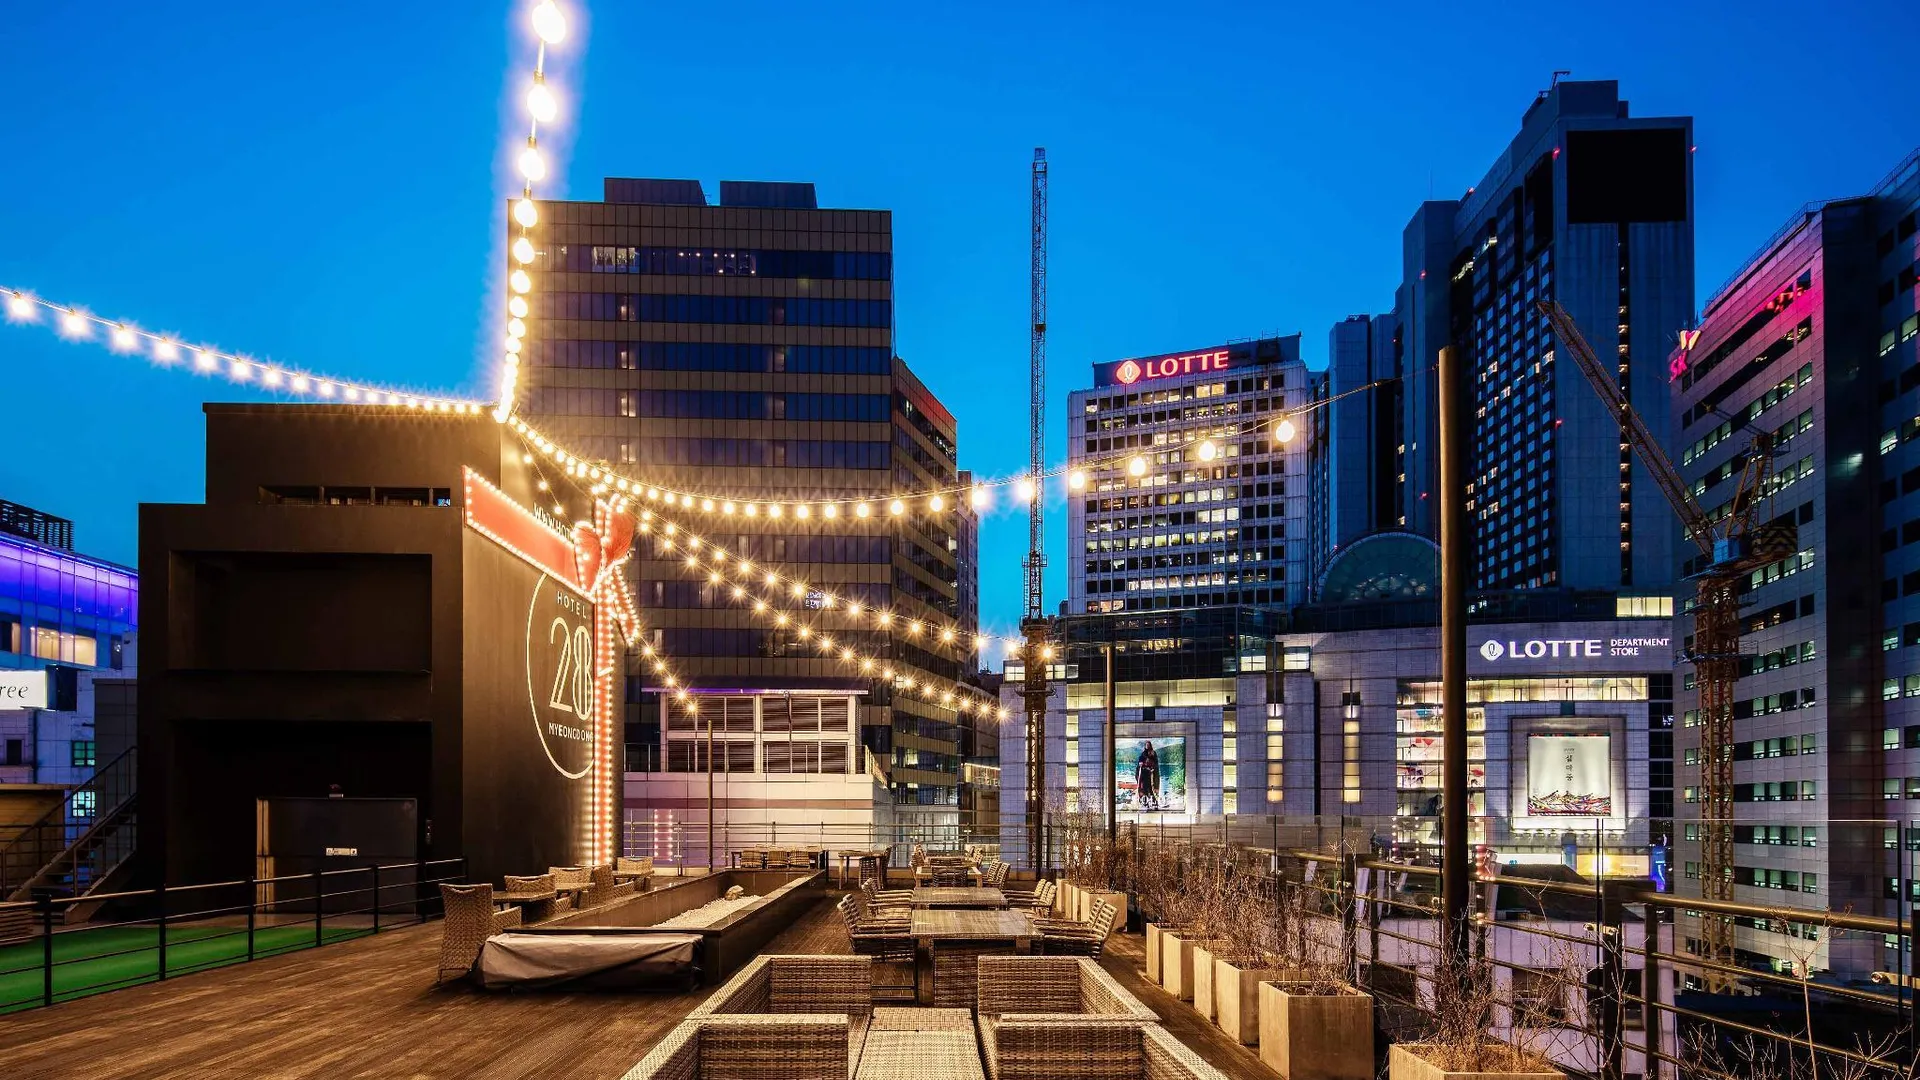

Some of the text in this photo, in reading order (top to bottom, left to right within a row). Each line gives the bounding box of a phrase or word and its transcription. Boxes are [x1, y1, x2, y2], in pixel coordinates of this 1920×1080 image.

[1147, 351, 1229, 377] LOTTE
[557, 591, 587, 619] HOTEL
[1509, 638, 1669, 658] LOTTE DEPARTMENT
[1610, 647, 1639, 656] STORE
[549, 617, 593, 720] 28
